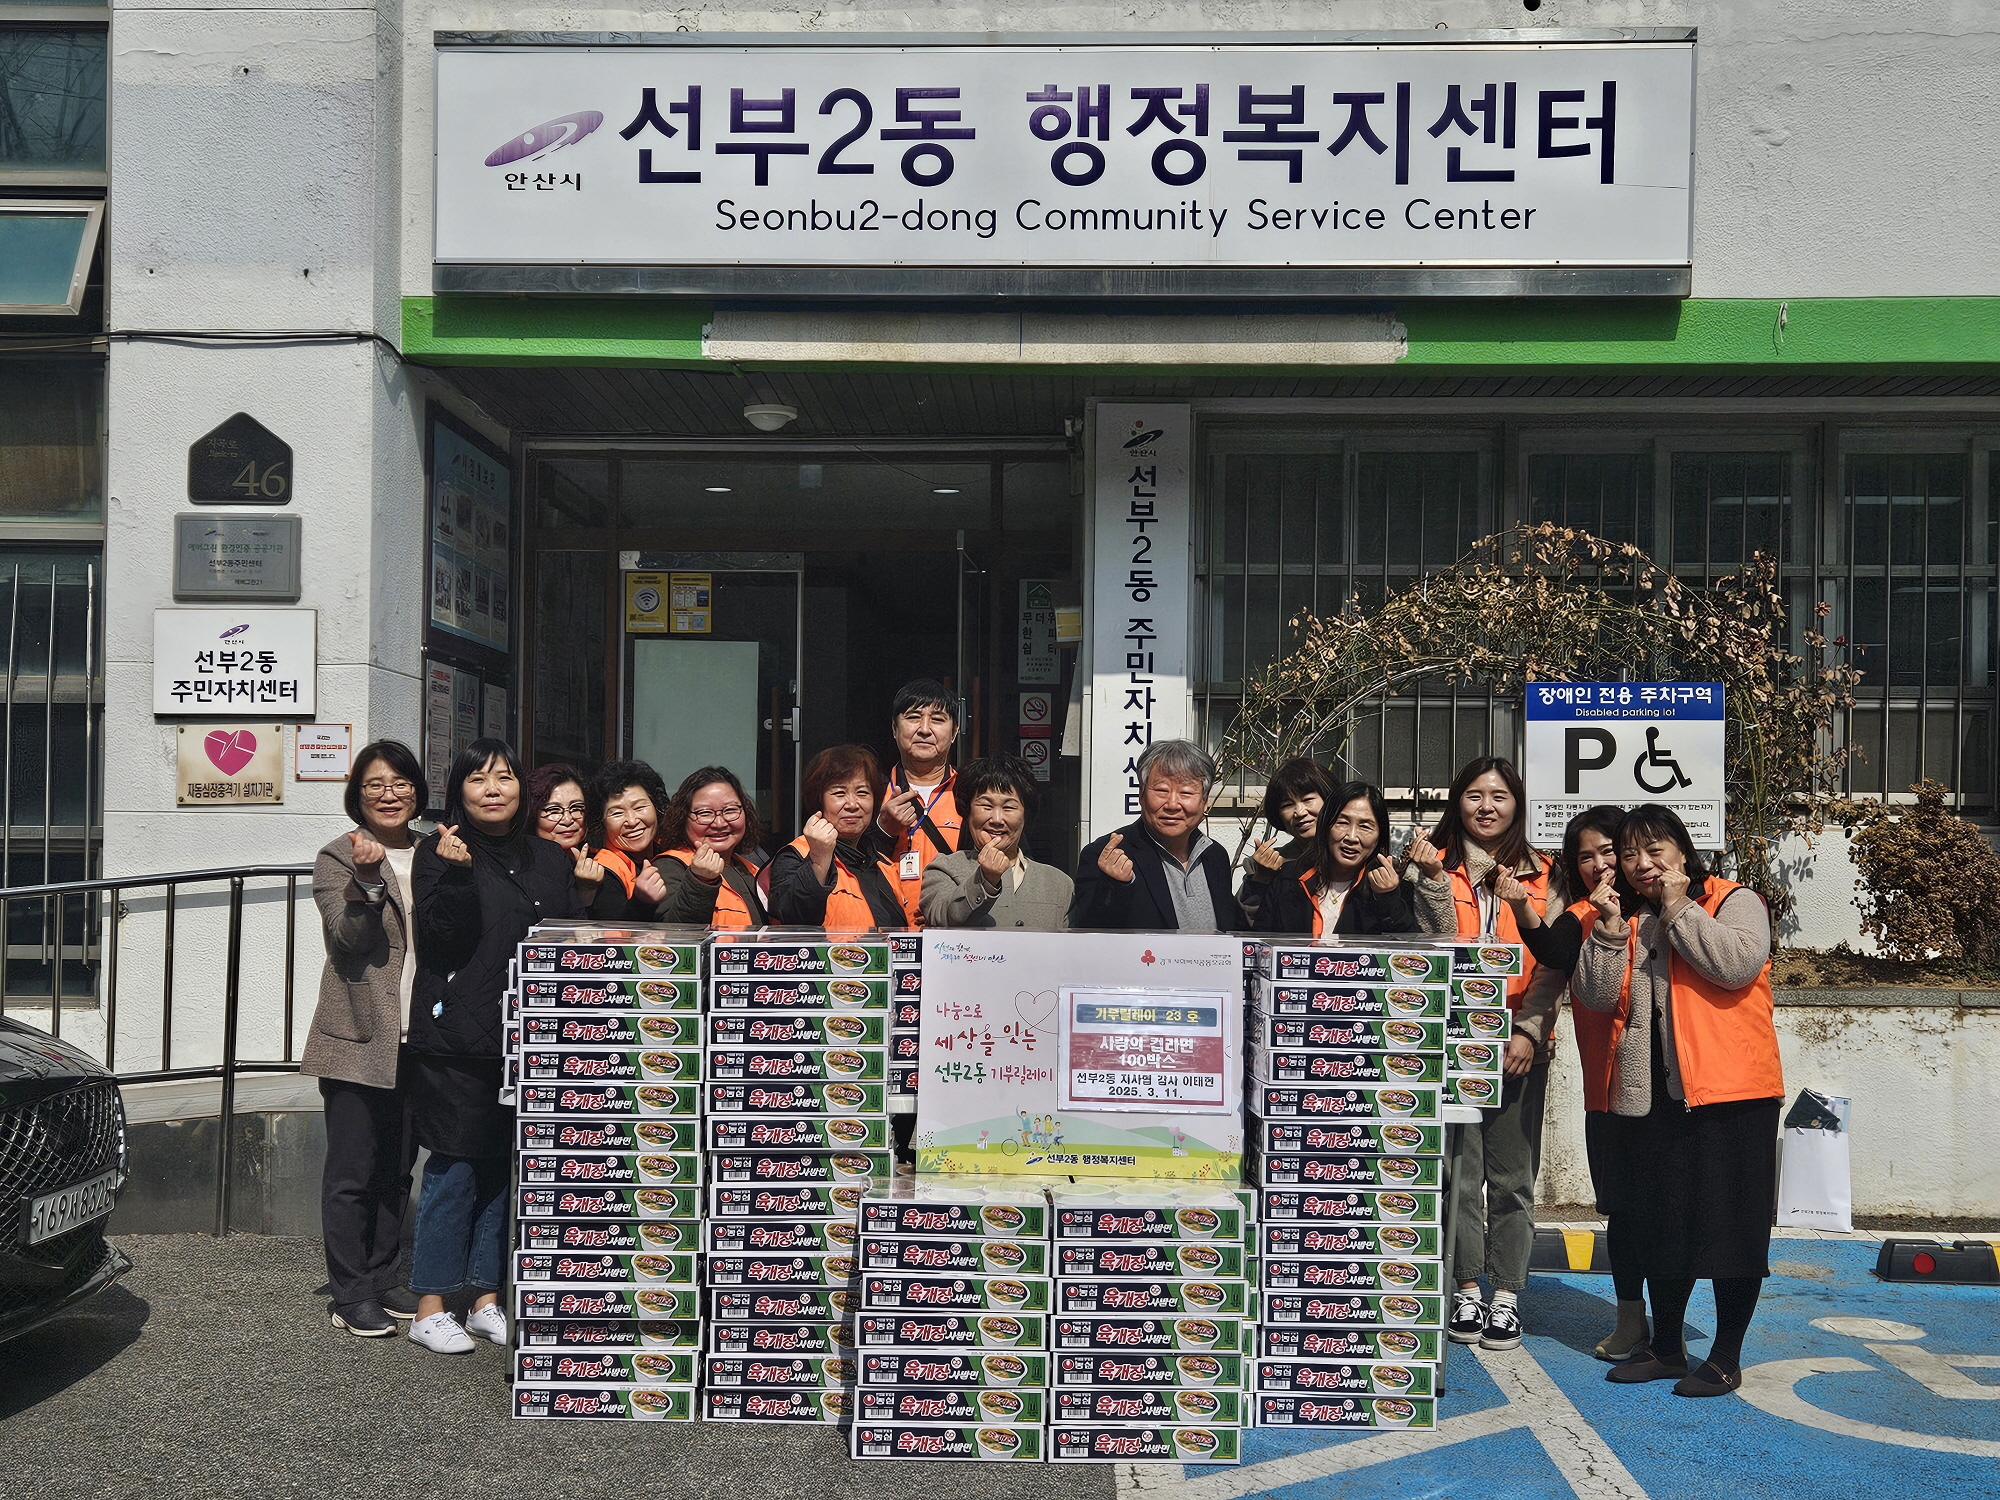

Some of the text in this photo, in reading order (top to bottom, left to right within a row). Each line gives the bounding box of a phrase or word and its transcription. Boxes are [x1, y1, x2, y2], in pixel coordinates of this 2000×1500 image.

[618, 80, 1617, 187] 선부2동 행정복지센터
[504, 172, 582, 191] 안산시
[716, 199, 1537, 239] Seonbu2-dong Community Service Center
[232, 460, 286, 498] 46
[1124, 465, 1159, 603] 선부2동
[194, 650, 278, 674] 선부2동
[170, 679, 298, 703] 주민자치센터
[1538, 687, 1712, 705] 장애인 전용 주차구역
[1575, 708, 1676, 717] Disabled parking lot
[1565, 727, 1617, 794] P
[561, 951, 605, 969] 육개장
[754, 952, 798, 970] 육개장
[1316, 958, 1358, 976] 육개장
[562, 986, 606, 1004] 육개장
[754, 986, 798, 1004] 육개장
[1313, 993, 1356, 1011] 육개장
[1095, 1007, 1199, 1023] 기부릴레이 23 호
[563, 1022, 607, 1040] 육개장
[751, 1022, 793, 1040] 육개장
[934, 1026, 995, 1056] 세상을
[1003, 1021, 1037, 1051] 잇는
[1310, 1026, 1353, 1043] 육개장
[1099, 1036, 1194, 1054] 사랑의 컵라면
[564, 1057, 608, 1075] 육개장
[750, 1056, 794, 1074] 육개장
[1118, 1053, 1177, 1069] 100박스
[1312, 1059, 1354, 1077] 육개장
[934, 1062, 987, 1084] 선부2동
[1076, 1073, 1116, 1085] 선부2동
[1156, 1075, 1179, 1087] 감사
[561, 1091, 605, 1109] 육개장
[749, 1090, 793, 1108] 육개장
[1108, 1086, 1183, 1099] 2025. 3. 11.
[1303, 1094, 1346, 1112] 육개장
[560, 1128, 604, 1145] 육개장
[752, 1125, 796, 1143] 육개장
[1308, 1130, 1350, 1148] 육개장
[562, 1160, 606, 1178] 육개장
[757, 1159, 800, 1177] 육개장
[1046, 1154, 1136, 1167] 선부2동 행정복지센터
[1305, 1162, 1348, 1180] 육개장
[560, 1194, 604, 1212] 육개장
[756, 1193, 800, 1211] 육개장
[1304, 1197, 1347, 1215] 육개장
[903, 1209, 949, 1229] 육개장
[1098, 1215, 1144, 1234] 육개장
[564, 1228, 608, 1246] 육개장
[750, 1228, 794, 1247] 육개장
[1305, 1232, 1348, 1250] 육개장
[904, 1246, 949, 1266] 육개장
[1100, 1252, 1146, 1271] 육개장
[557, 1259, 601, 1277] 육개장
[749, 1262, 792, 1280] 육개장
[1305, 1266, 1347, 1284] 육개장
[907, 1284, 953, 1303] 육개장
[1104, 1289, 1149, 1308] 육개장
[560, 1296, 604, 1314] 육개장
[755, 1297, 799, 1315] 육개장
[1307, 1301, 1350, 1319] 육개장
[754, 1331, 798, 1349] 육개장
[901, 1322, 946, 1341] 육개장
[1097, 1325, 1143, 1344] 육개장
[1304, 1335, 1347, 1353] 육개장
[558, 1359, 602, 1377] 육개장
[748, 1364, 792, 1382] 육개장
[905, 1361, 950, 1380] 육개장
[1099, 1361, 1145, 1381] 육개장
[1297, 1369, 1340, 1388] 육개장
[555, 1395, 598, 1413] 육개장
[747, 1397, 790, 1415] 육개장
[900, 1397, 946, 1416] 육개장
[1097, 1397, 1142, 1416] 육개장
[1300, 1402, 1343, 1421] 육개장
[898, 1433, 944, 1452] 육개장
[1096, 1435, 1141, 1454] 육개장
